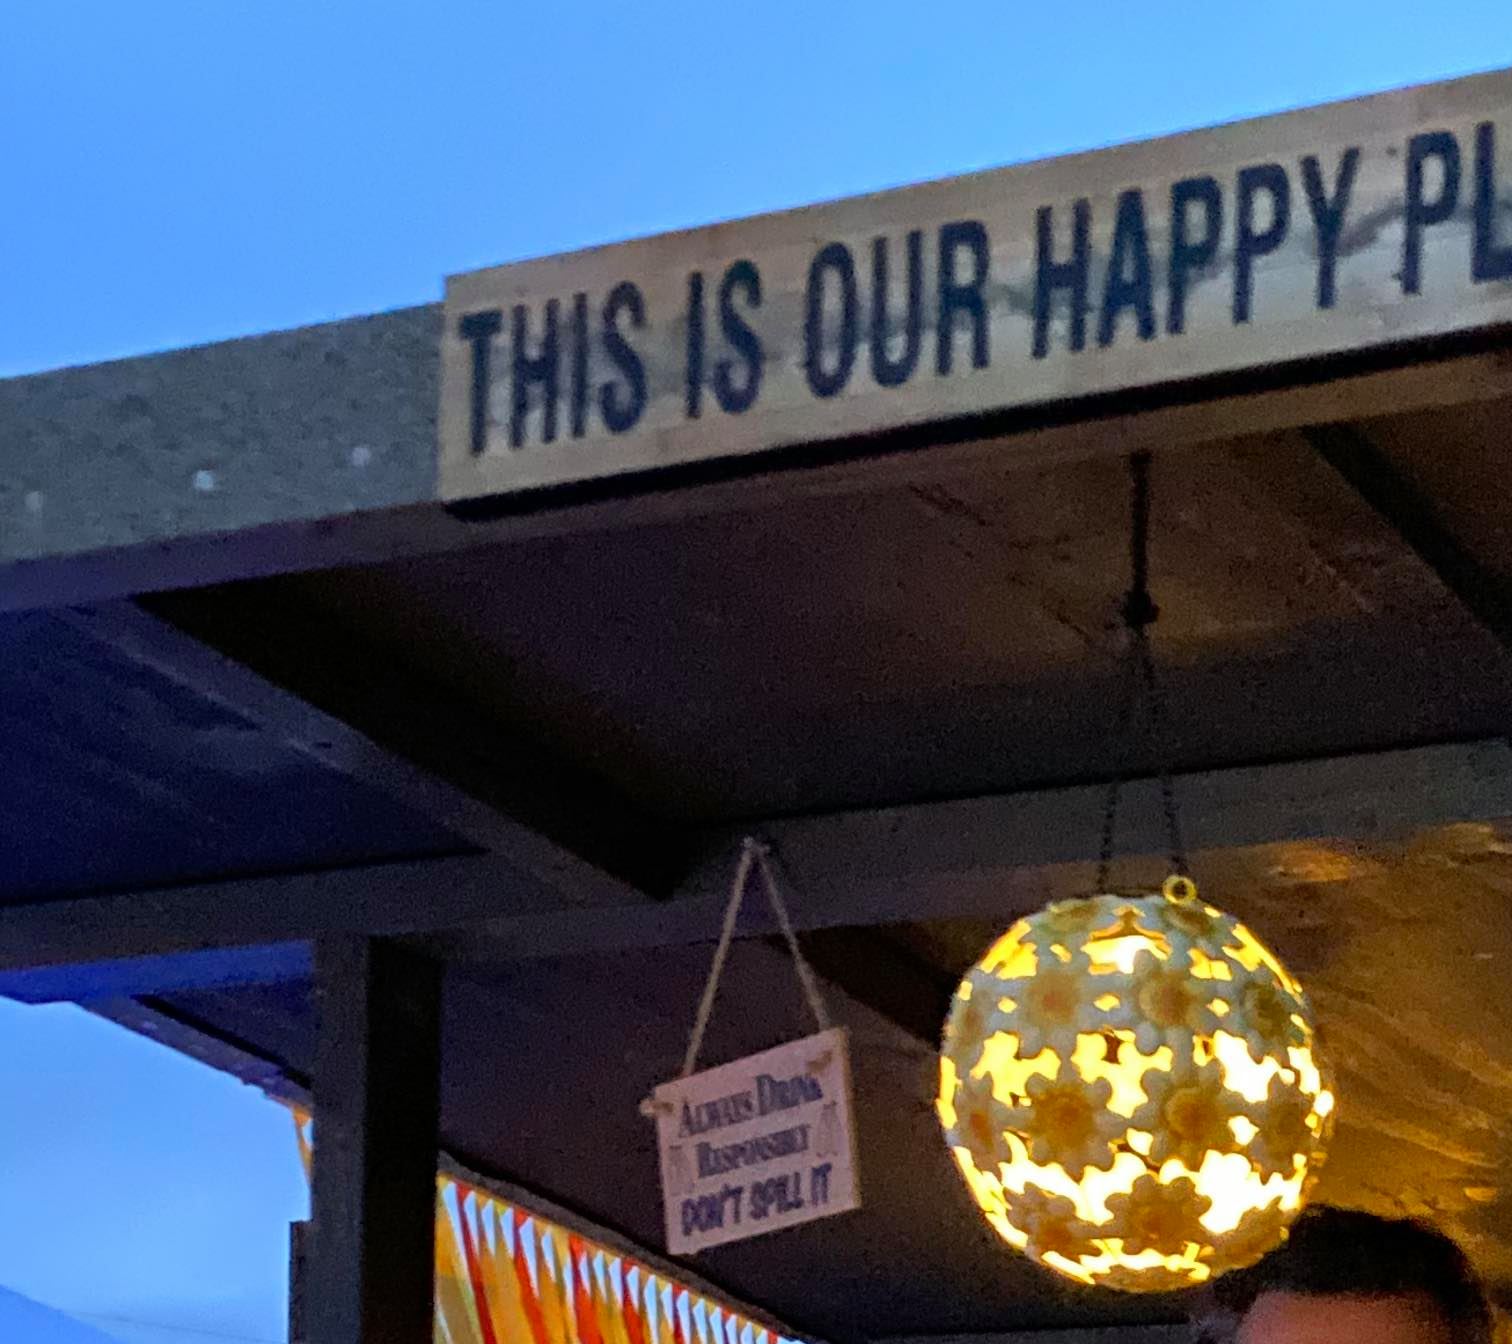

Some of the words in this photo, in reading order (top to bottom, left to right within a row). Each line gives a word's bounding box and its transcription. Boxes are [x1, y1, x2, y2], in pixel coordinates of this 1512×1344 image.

[457, 280, 647, 458] THIS
[686, 259, 764, 420] IS
[803, 217, 992, 400] OUR
[1031, 145, 1360, 360] HAPPY
